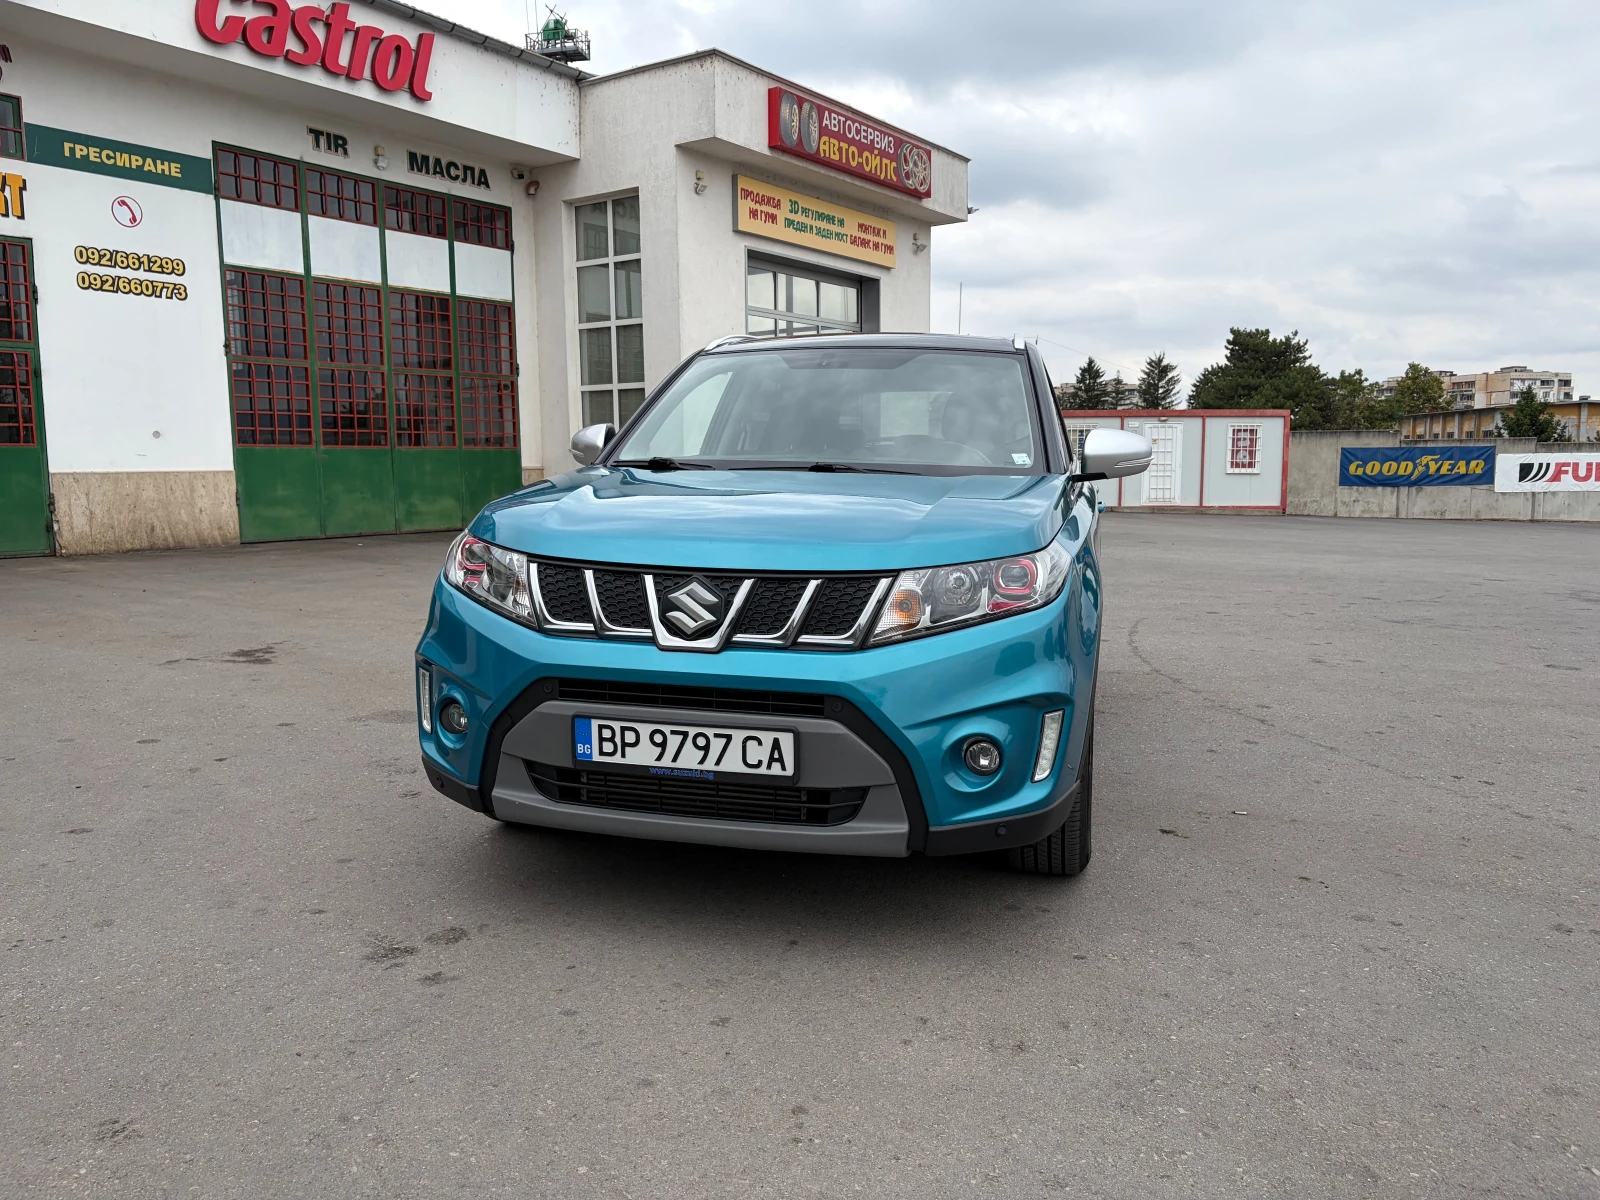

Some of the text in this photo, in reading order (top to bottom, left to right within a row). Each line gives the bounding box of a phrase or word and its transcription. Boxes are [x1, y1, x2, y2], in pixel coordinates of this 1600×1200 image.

[306, 125, 349, 159] TIR
[822, 110, 895, 154] АВТОСЕРВИЗ
[63, 141, 182, 178] ГРЕСИРАНЕ
[406, 149, 491, 191] МАСЛА
[819, 136, 897, 182] АВТО-ОЙЛС
[740, 187, 781, 211] ПРОДАЖБА
[788, 198, 845, 228] 3D РЕГУЛИРАНЕ НА
[748, 206, 777, 225] НА ГУМИ
[784, 217, 849, 244] ПРЕДЕН И ЗАДЕН МОСТ
[857, 221, 882, 239] МОНТАЖ
[849, 233, 895, 255] БАЛАНС НА ГУМИ
[74, 245, 186, 276] 092/661299
[77, 271, 188, 301] 092/660773
[1543, 461, 1600, 483] FU
[577, 743, 591, 754] BG
[598, 723, 787, 771] BP 9797 CA
